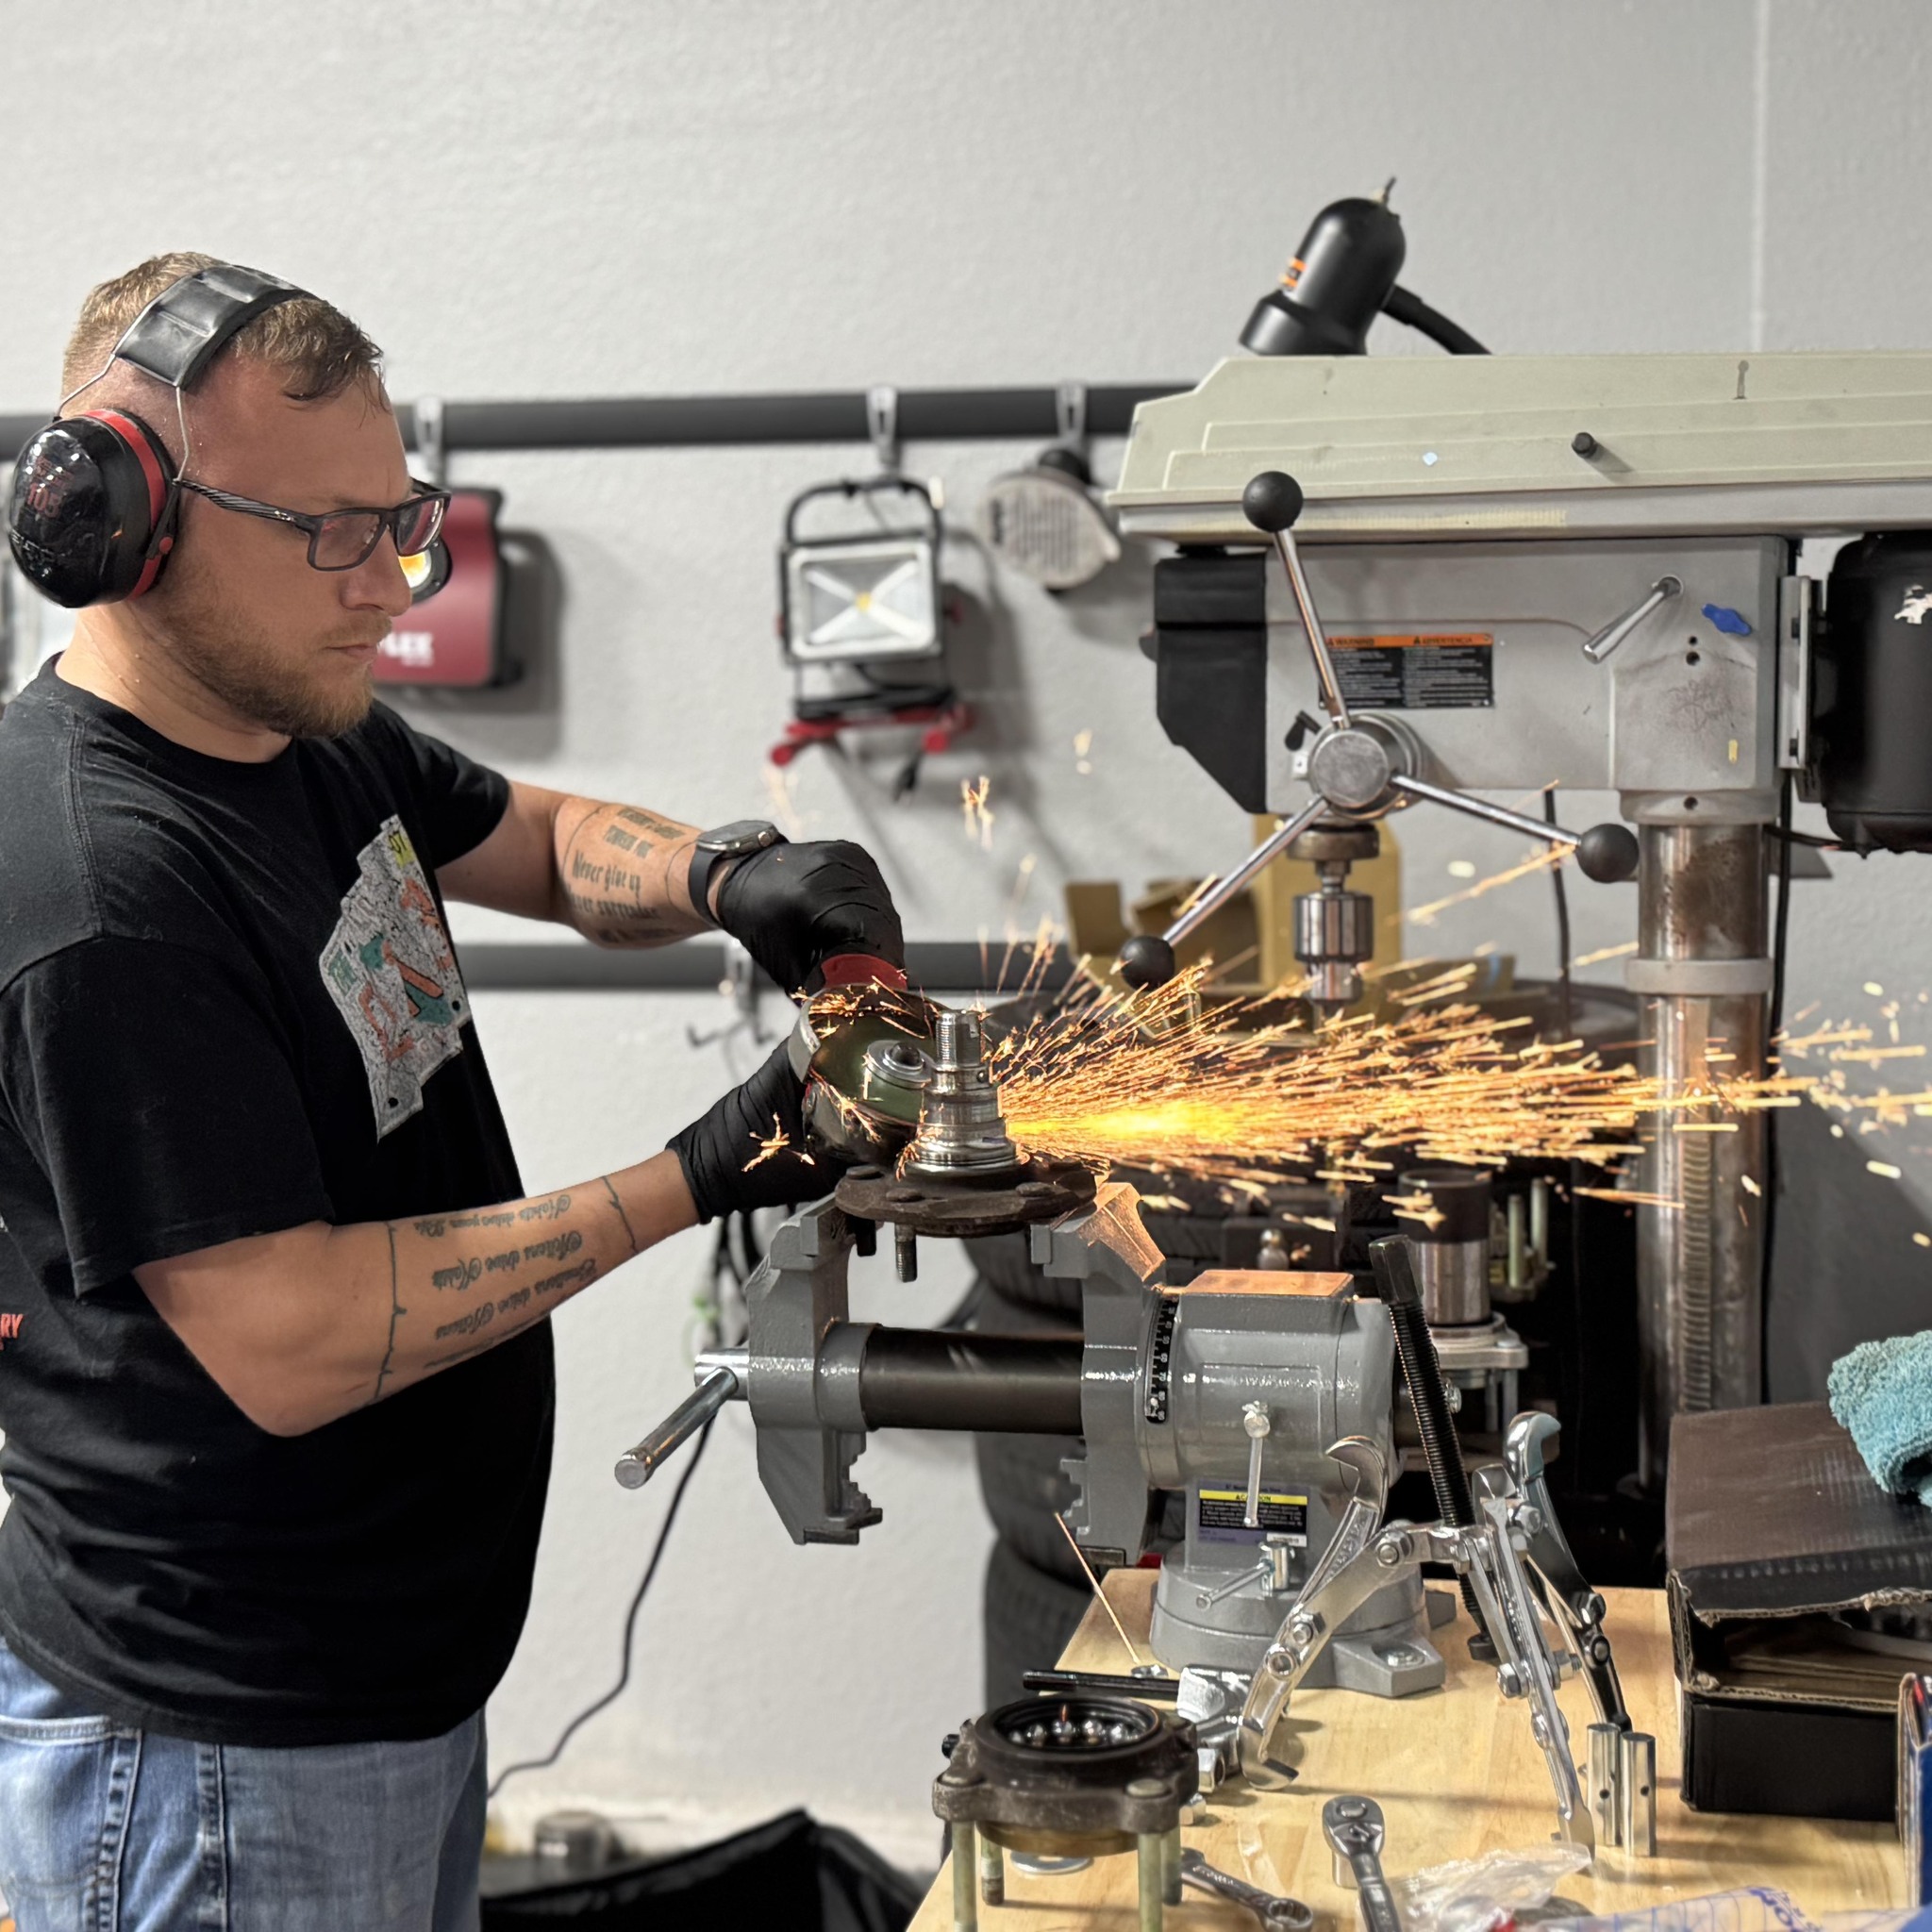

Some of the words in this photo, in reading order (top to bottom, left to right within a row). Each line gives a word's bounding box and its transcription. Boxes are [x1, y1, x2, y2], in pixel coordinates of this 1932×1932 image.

[572, 850, 604, 883] Never
[605, 864, 626, 892] give
[524, 1230, 582, 1260] Actions
[485, 1250, 521, 1272] drive
[497, 1287, 531, 1313] drive
